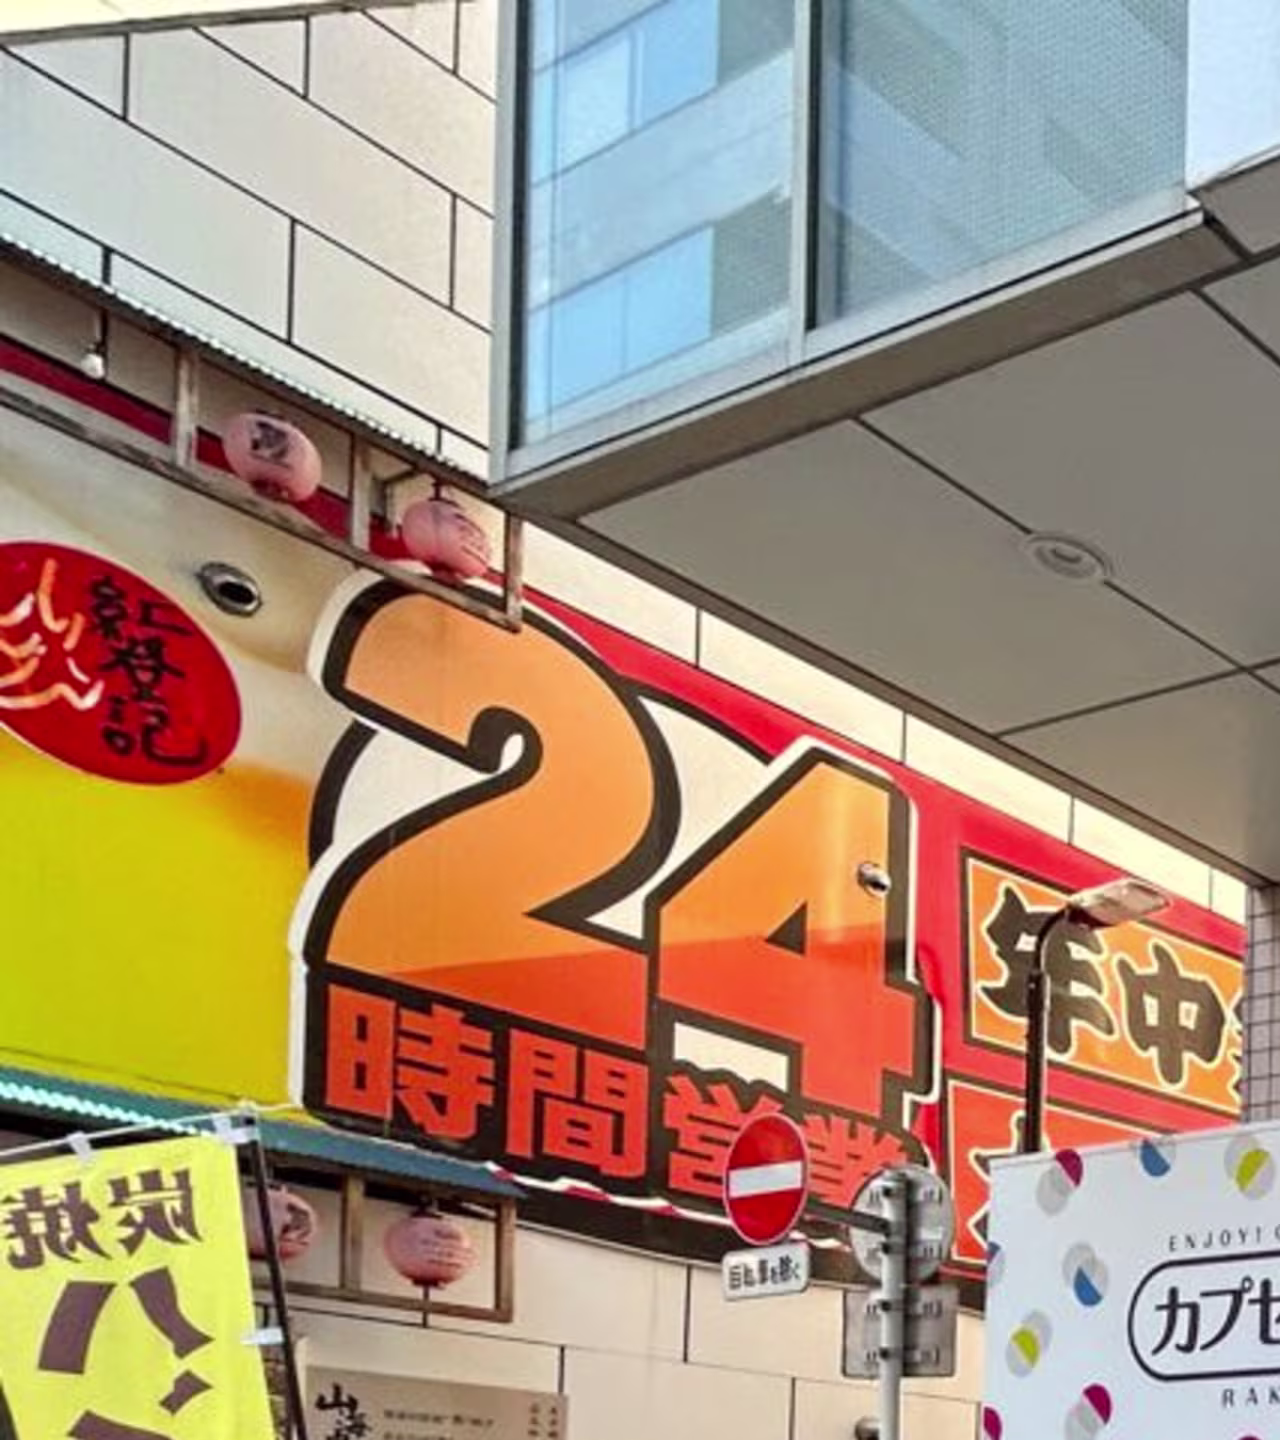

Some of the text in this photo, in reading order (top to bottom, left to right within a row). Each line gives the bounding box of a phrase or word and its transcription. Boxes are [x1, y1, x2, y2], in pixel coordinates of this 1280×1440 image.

[315, 588, 916, 1120] 24
[980, 886, 1243, 1090] 年中
[1168, 1225, 1262, 1251] ENJOY!
